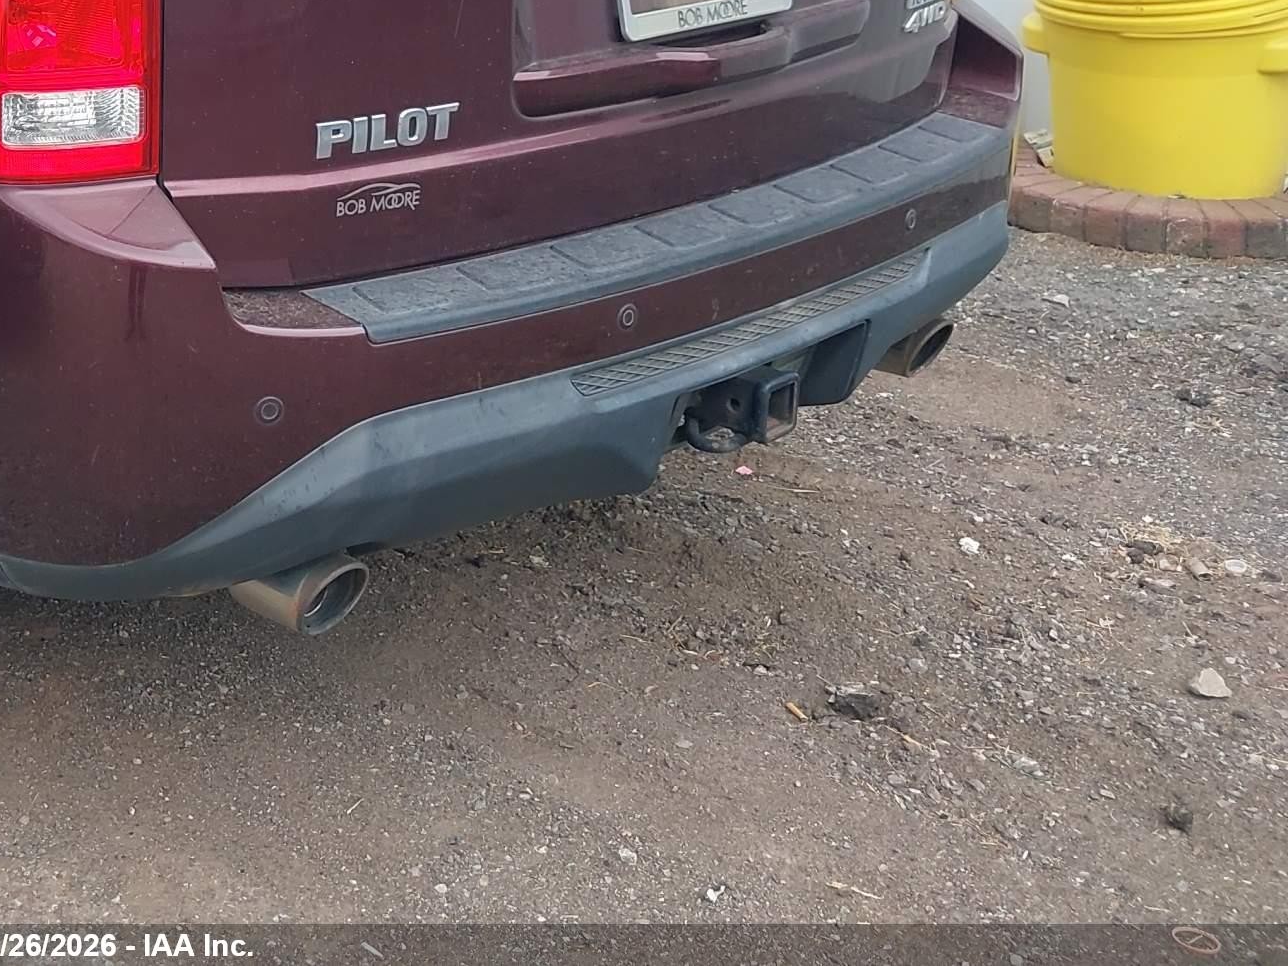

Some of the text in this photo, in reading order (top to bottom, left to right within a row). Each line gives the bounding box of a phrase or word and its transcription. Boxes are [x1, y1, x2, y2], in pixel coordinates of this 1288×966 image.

[677, 7, 703, 28] BOB
[903, 0, 947, 33] 4WD
[315, 101, 461, 160] PILOT
[336, 190, 421, 218] BOB MOORE
